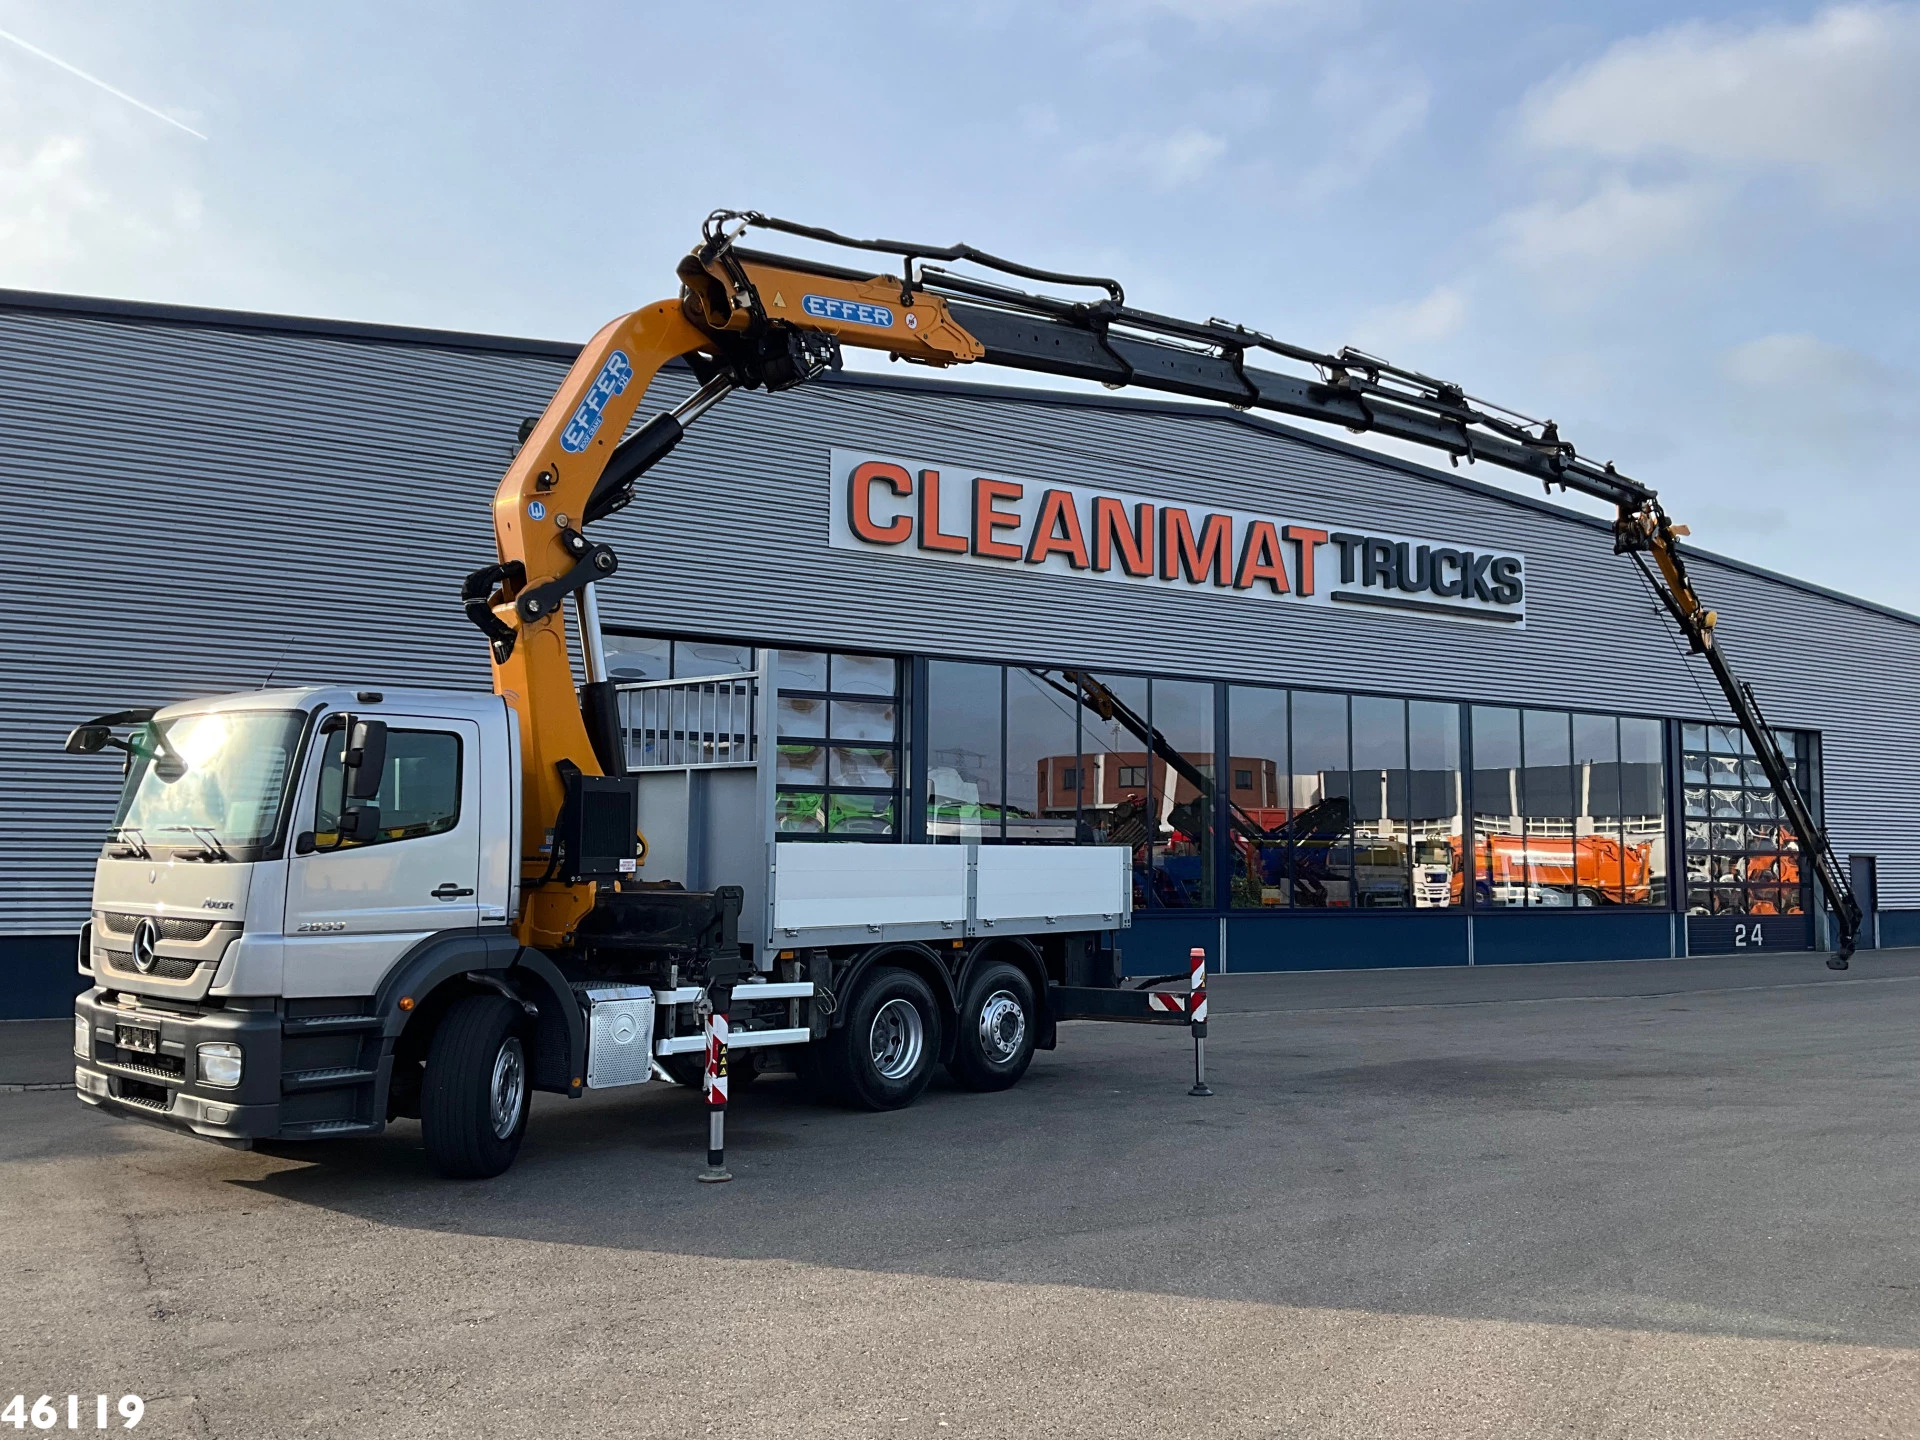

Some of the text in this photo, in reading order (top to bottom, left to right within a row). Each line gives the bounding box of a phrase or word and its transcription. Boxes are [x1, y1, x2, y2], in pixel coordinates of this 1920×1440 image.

[808, 297, 889, 325] EFFER
[564, 354, 627, 447] EFFER
[847, 460, 1523, 604] CLEANMAT TRUCKS
[1735, 923, 1763, 947] 24
